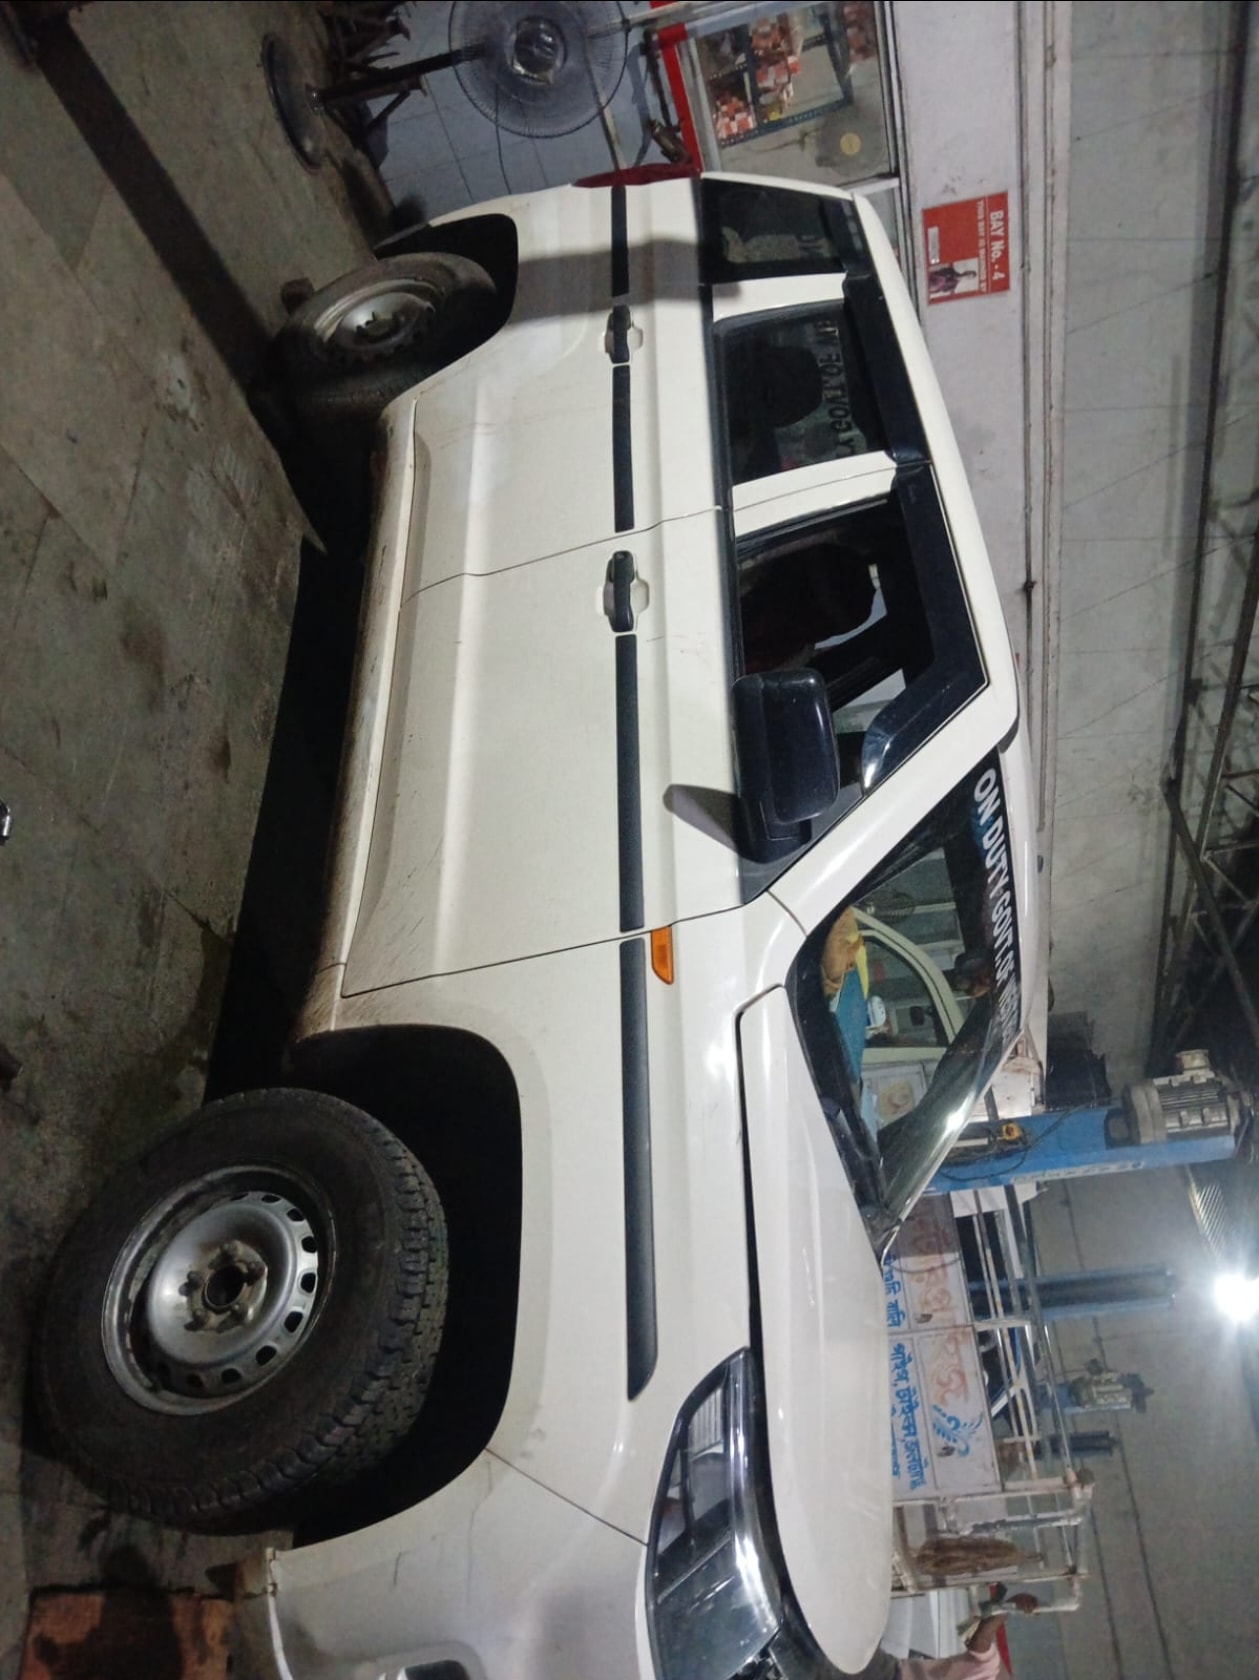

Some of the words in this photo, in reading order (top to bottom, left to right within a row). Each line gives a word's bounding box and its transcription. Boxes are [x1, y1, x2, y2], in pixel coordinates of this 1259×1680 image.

[990, 210, 1004, 236] BAY
[991, 240, 1005, 263] No.
[992, 272, 1006, 280] 4
[974, 768, 1000, 825] ON
[982, 815, 1009, 899] DUTY
